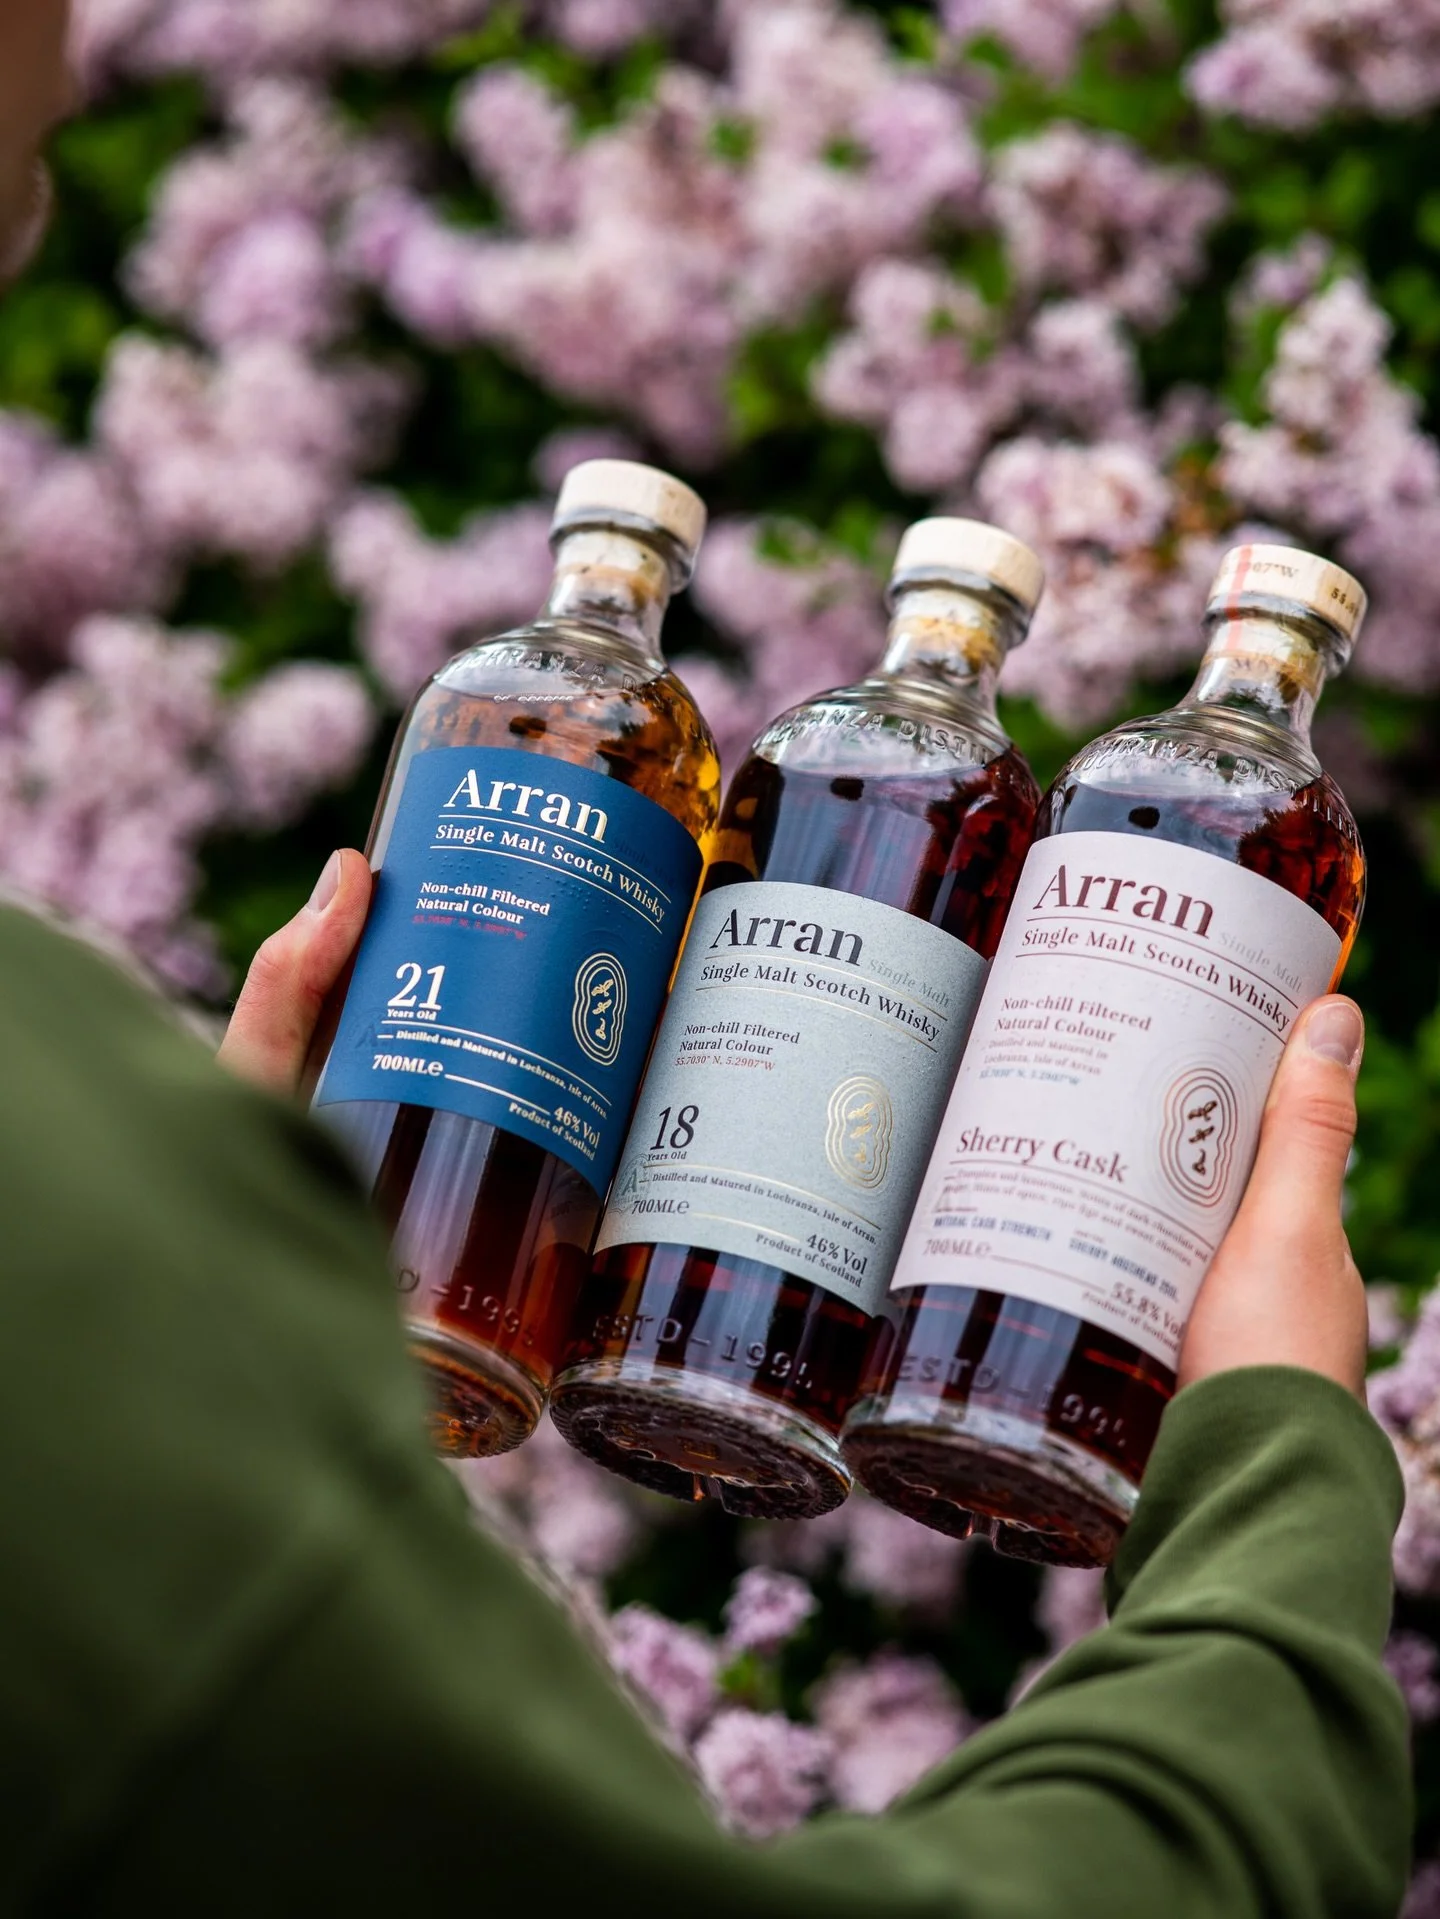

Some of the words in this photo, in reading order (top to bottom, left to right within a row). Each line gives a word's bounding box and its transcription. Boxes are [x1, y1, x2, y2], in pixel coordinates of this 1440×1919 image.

[443, 769, 609, 844] Arran
[435, 824, 495, 844] Single
[500, 830, 547, 856] Malt
[551, 845, 614, 883] Scotch
[619, 873, 666, 923] Whisky
[416, 898, 469, 913] Natural
[472, 903, 524, 925] Colour
[420, 882, 488, 899] Non-chill
[490, 889, 550, 916] Filtered
[1032, 864, 1214, 940] Arran
[709, 908, 865, 968] Arran
[1217, 932, 1271, 967] Single
[387, 962, 446, 1010] 21
[701, 962, 749, 983] Single
[754, 965, 799, 985] Malt
[803, 973, 871, 1006] Scotch
[877, 995, 940, 1043] Whisky
[869, 959, 916, 991] Single
[921, 982, 953, 1008] Malt
[1021, 926, 1079, 949] Single
[1085, 931, 1136, 955] Malt
[1143, 943, 1220, 985] Scotch
[1228, 974, 1291, 1033] Whisky
[387, 1009, 414, 1019] Years
[416, 1010, 437, 1021] Old
[684, 1021, 740, 1036] Non-chill
[743, 1024, 800, 1044] Filtered
[994, 1016, 1050, 1032] Natural
[1054, 1018, 1117, 1043] Colour
[1000, 995, 1074, 1012] Non-chill
[1078, 1001, 1152, 1031] Filtered
[396, 1030, 439, 1044] Distilled
[440, 1038, 461, 1049] and
[462, 1040, 506, 1061] Matured
[506, 1053, 518, 1065] in
[582, 1094, 593, 1105] of
[679, 1038, 722, 1053] Natural
[725, 1039, 774, 1056] Colour
[508, 1102, 550, 1129] Product
[552, 1125, 564, 1136] of
[564, 1130, 595, 1161] Scotland
[553, 1106, 581, 1133] 46%
[583, 1120, 601, 1149] Vol
[649, 1104, 700, 1151] 18
[647, 1152, 668, 1162] Years
[670, 1151, 688, 1160] Old
[956, 1126, 1046, 1165] Sherry
[1052, 1138, 1130, 1184] Cask
[652, 1172, 688, 1182] Distilled
[689, 1173, 707, 1184] and
[710, 1175, 751, 1192] Matured
[753, 1183, 764, 1196] in
[767, 1186, 820, 1216] Lochranza,
[823, 1209, 840, 1224] Isle
[841, 1219, 852, 1230] of
[755, 1233, 802, 1257] Product
[804, 1253, 819, 1264] of
[819, 1258, 862, 1288] Scotland
[806, 1233, 841, 1260] 46%
[843, 1247, 868, 1276] Vol
[1110, 1281, 1161, 1321] 55.8%
